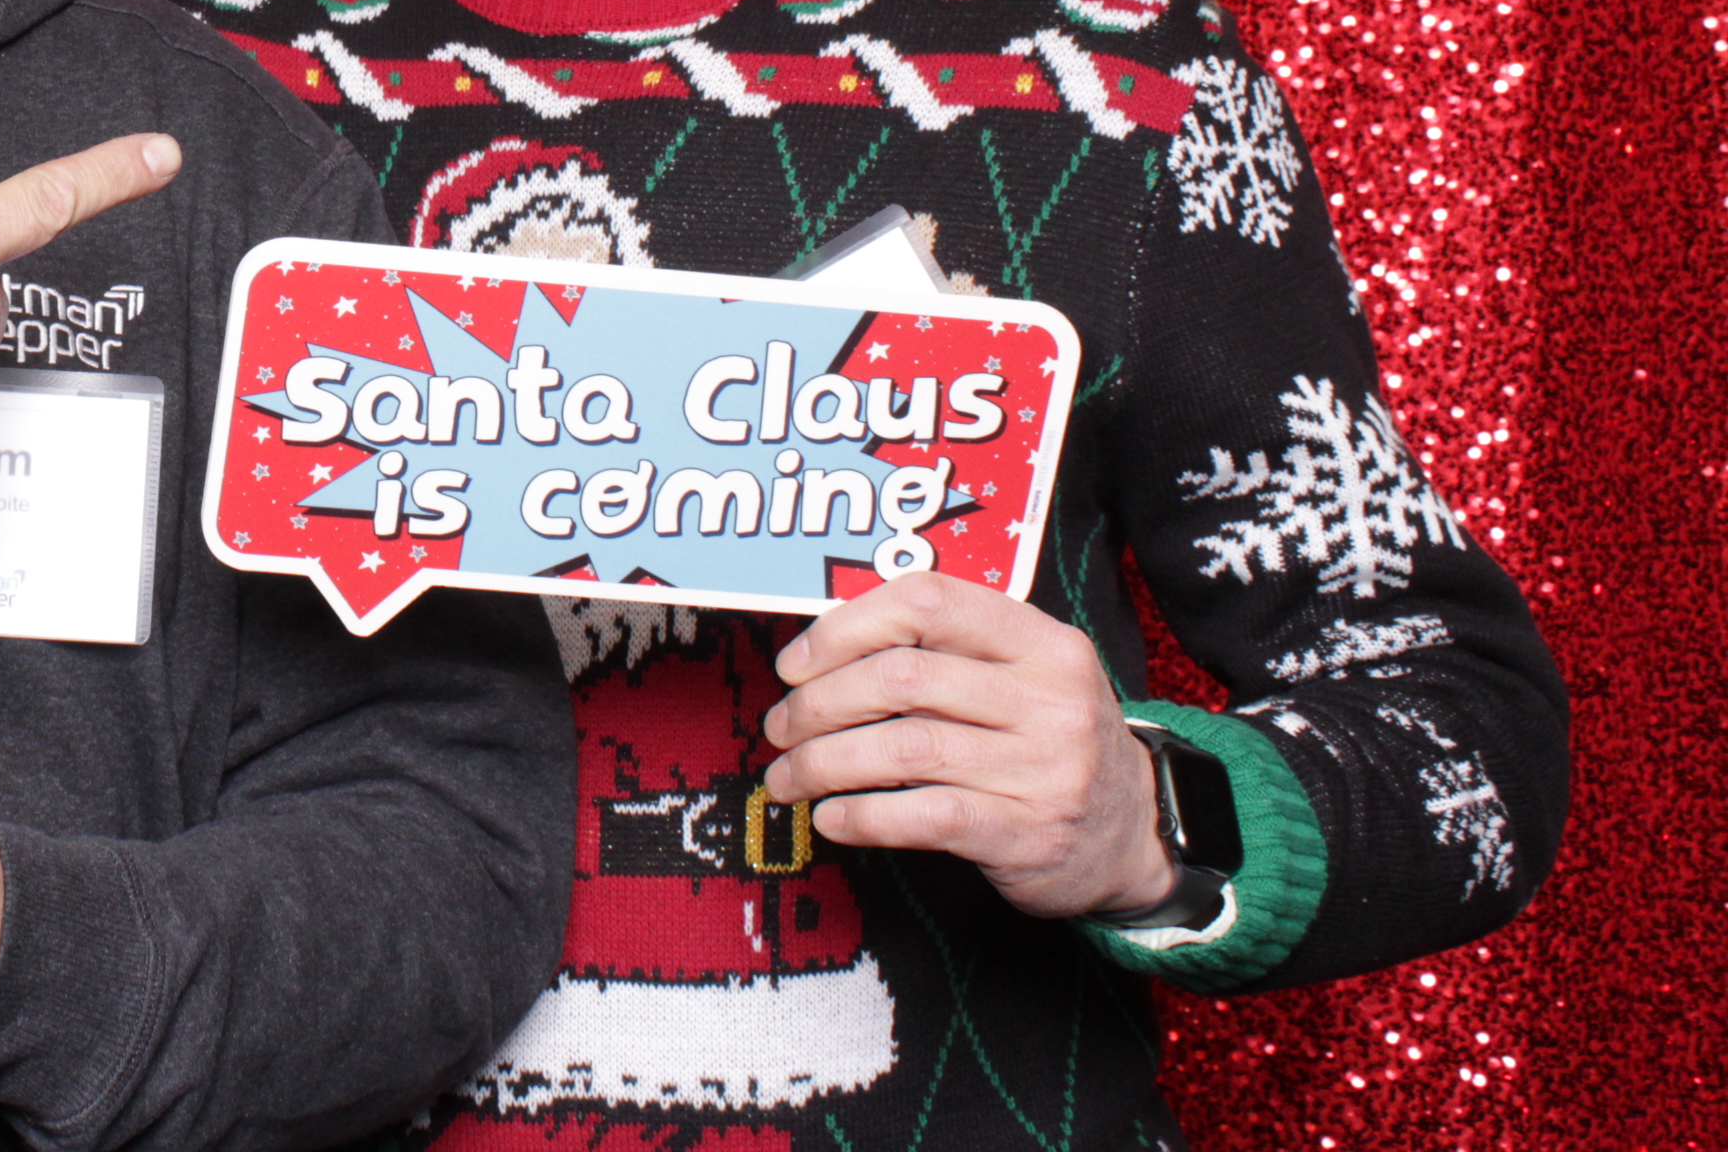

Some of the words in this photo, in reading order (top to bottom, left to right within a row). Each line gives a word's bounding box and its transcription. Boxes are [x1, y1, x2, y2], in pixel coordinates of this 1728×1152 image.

[2, 273, 123, 335] tman
[280, 345, 642, 445] Santa
[683, 341, 1009, 445] Claus
[374, 449, 471, 538] is
[521, 450, 954, 581] coming
